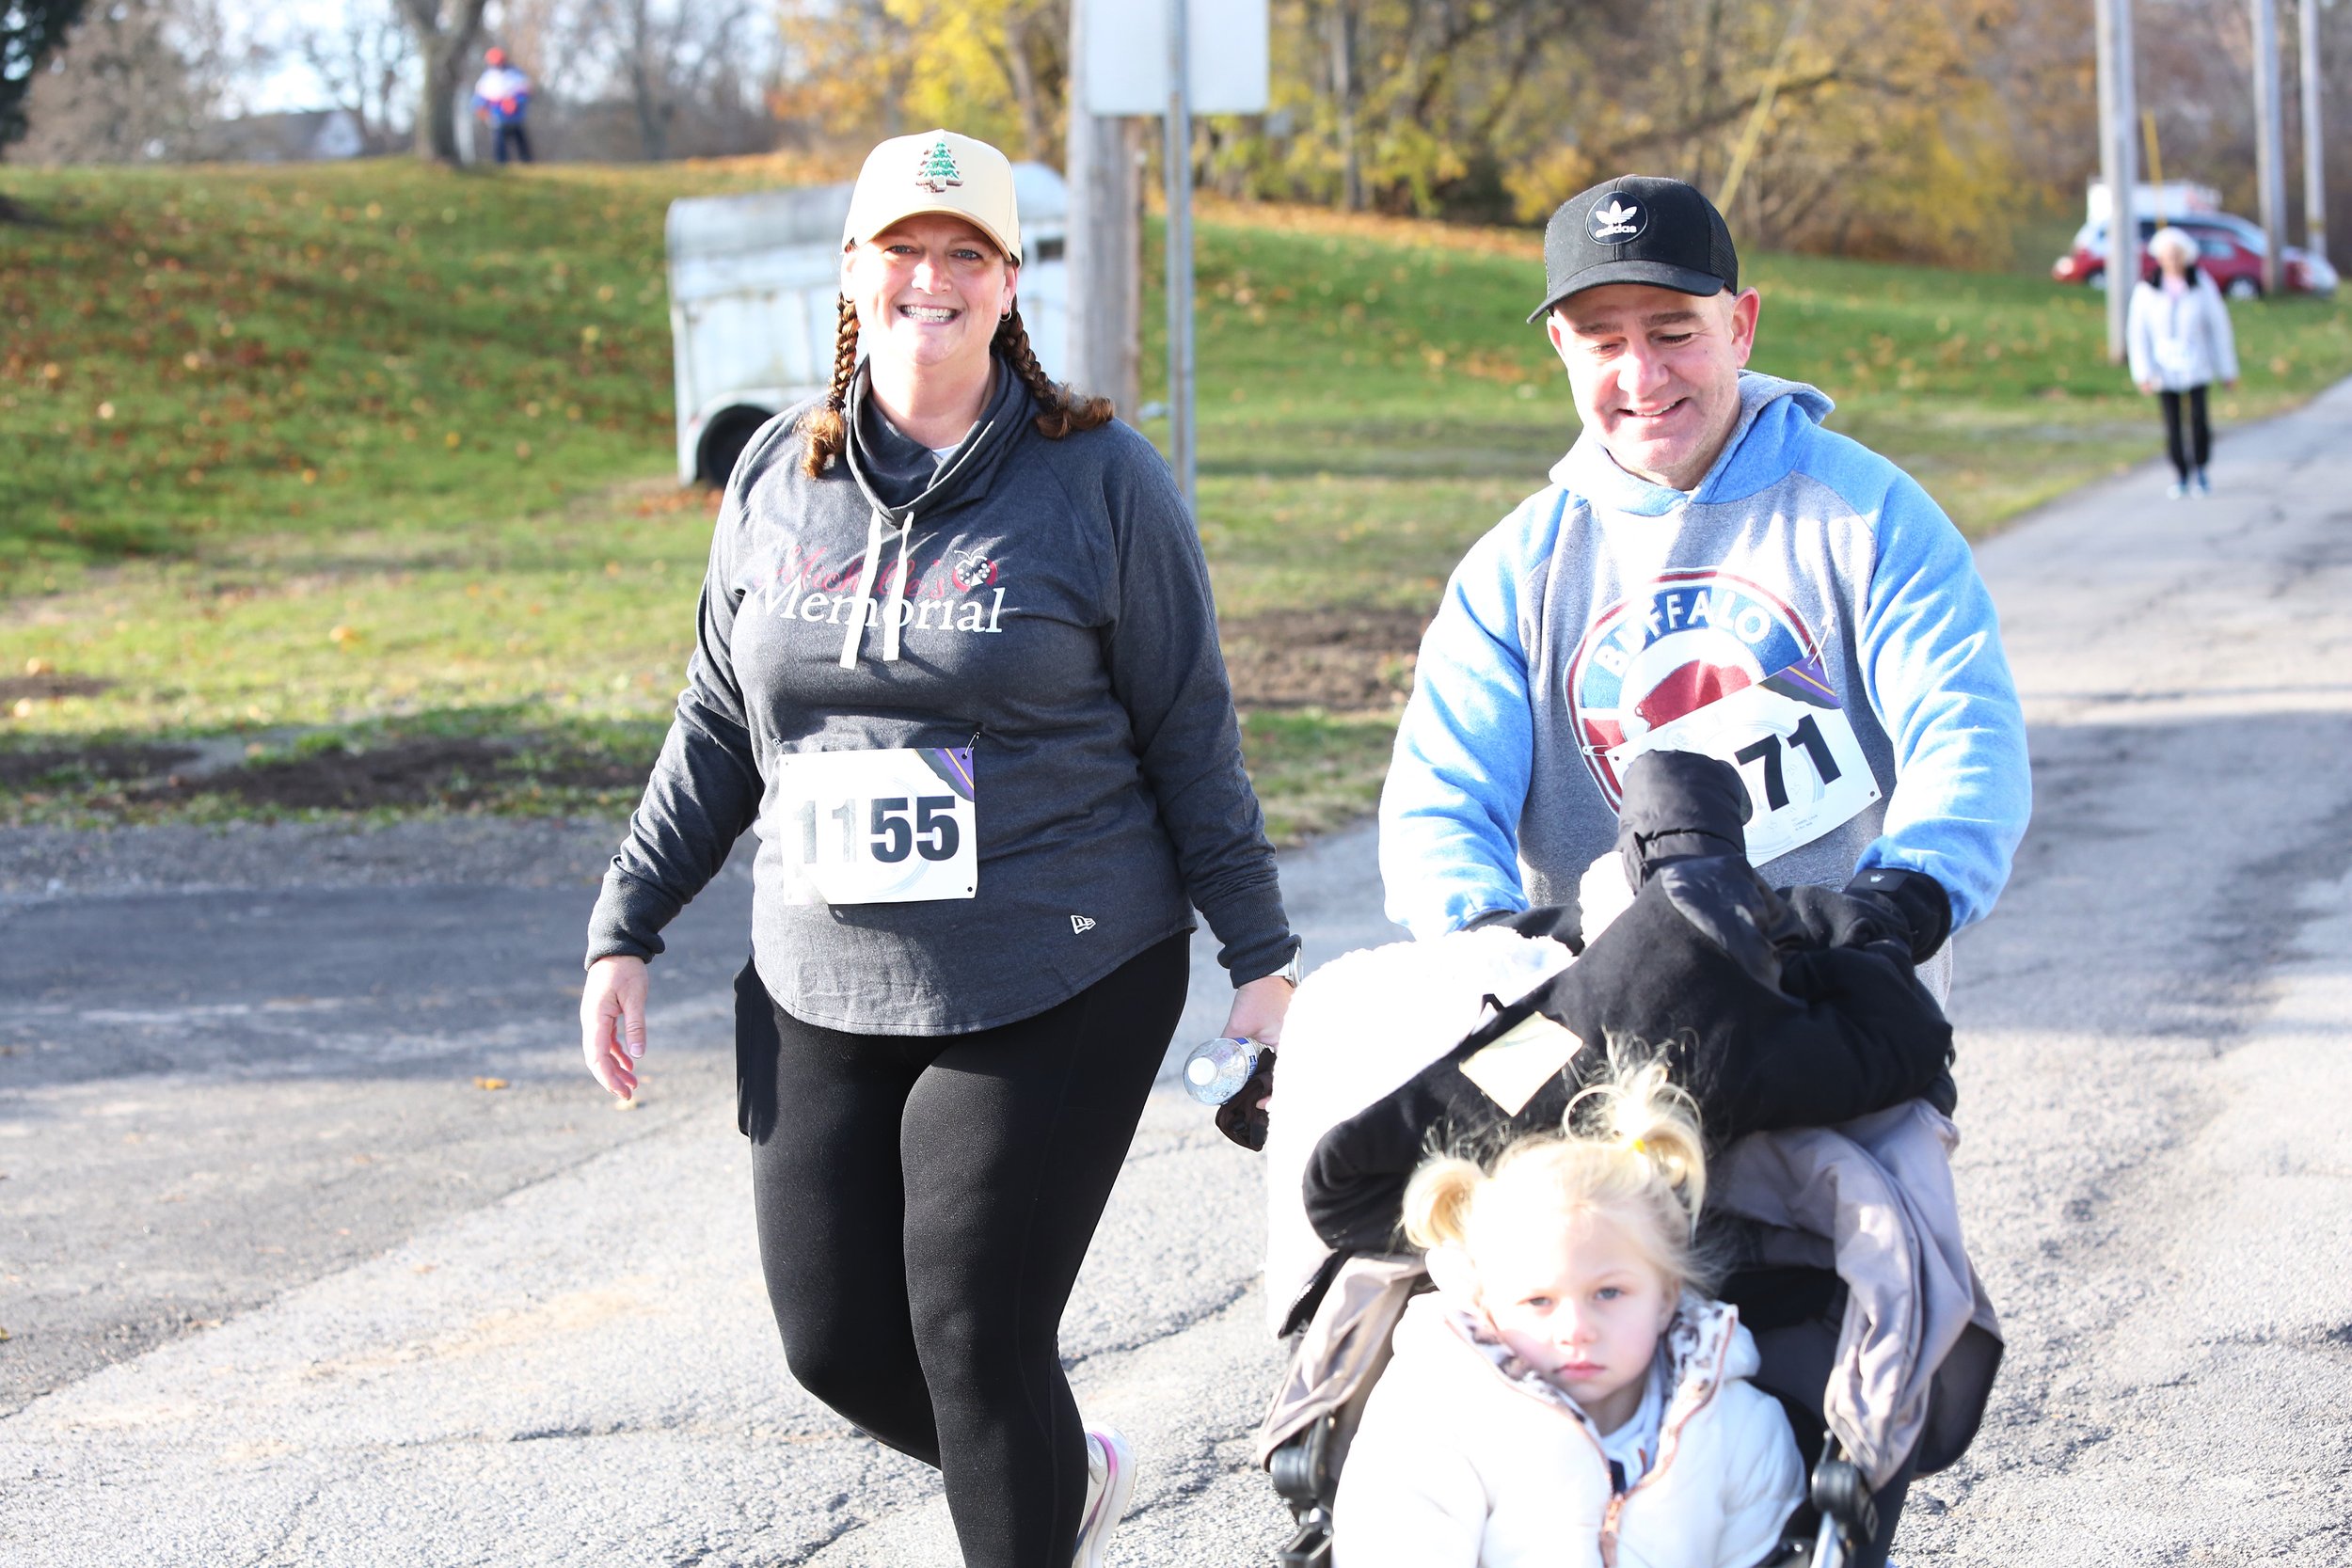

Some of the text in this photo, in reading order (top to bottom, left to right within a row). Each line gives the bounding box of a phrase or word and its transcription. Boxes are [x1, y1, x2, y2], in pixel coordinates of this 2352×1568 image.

[1595, 223, 1637, 238] adidas
[749, 578, 1005, 633] Memorial
[1594, 591, 1772, 677] BUFFALO
[1716, 713, 1842, 828] 71
[793, 795, 960, 863] 1155
